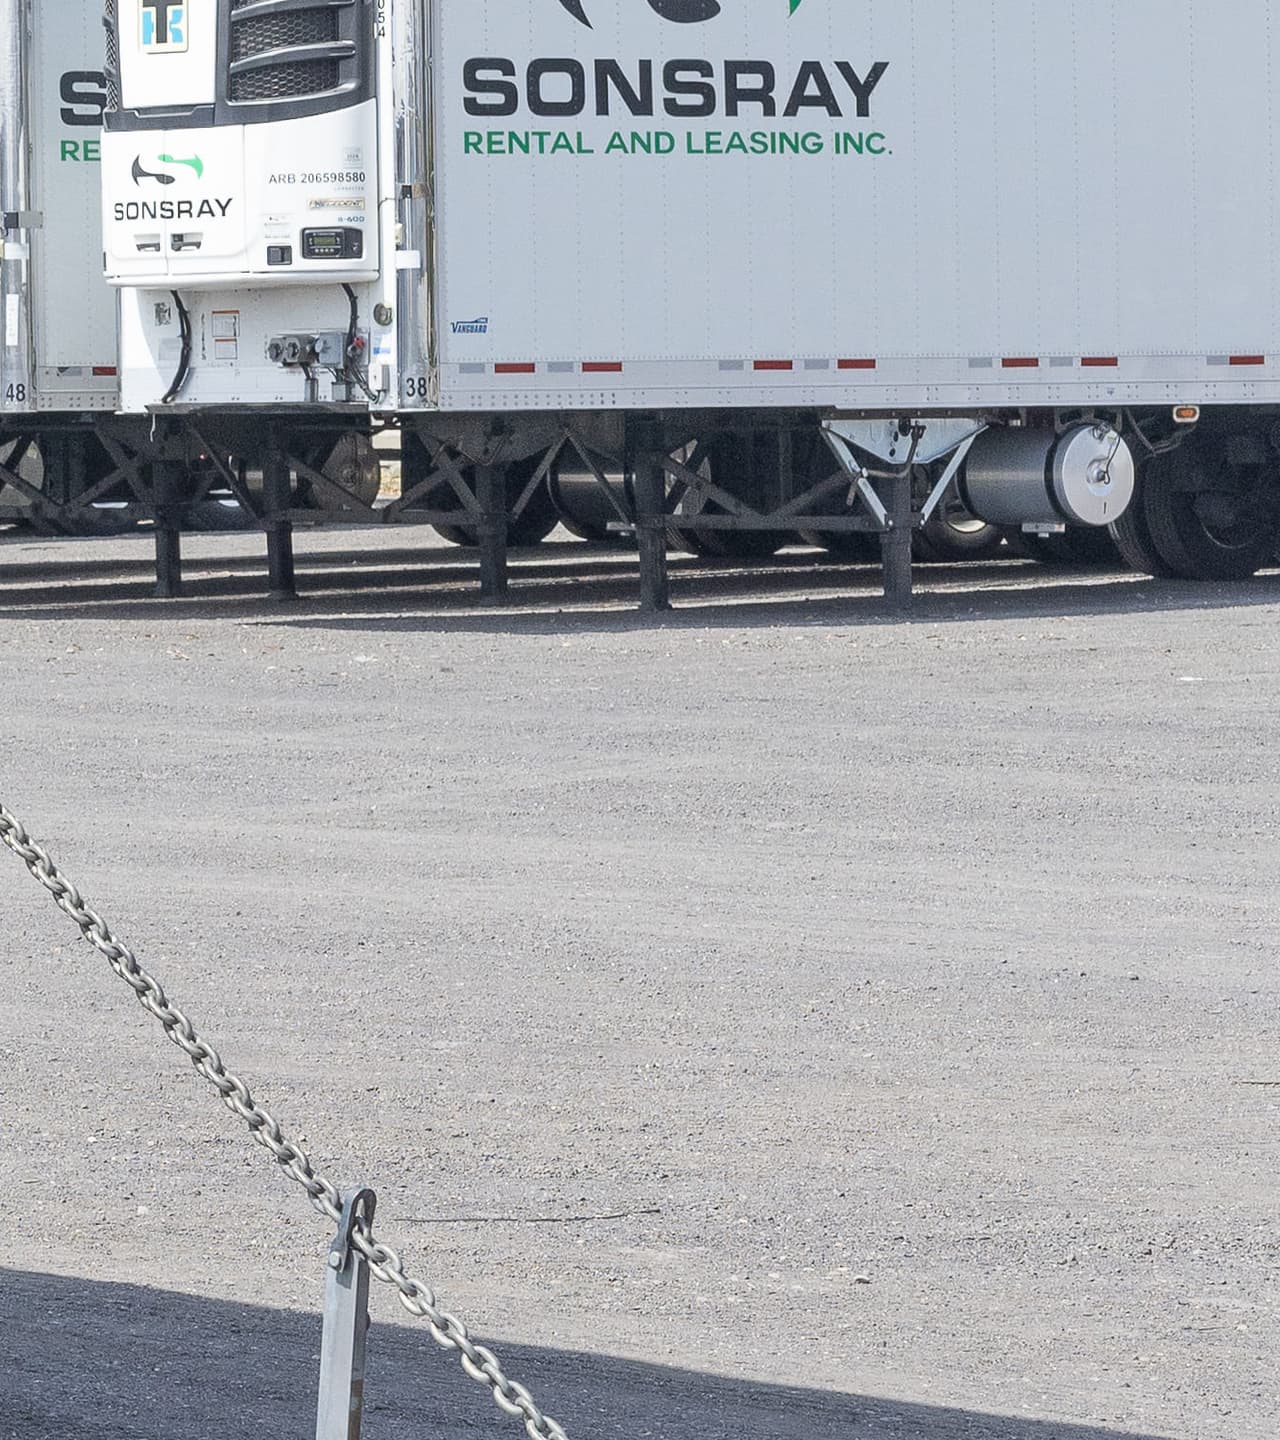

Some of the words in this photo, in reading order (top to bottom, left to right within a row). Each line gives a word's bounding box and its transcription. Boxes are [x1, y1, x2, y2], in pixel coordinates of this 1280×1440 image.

[462, 57, 890, 118] SONSRAY
[463, 130, 594, 155] RENTAL
[604, 130, 676, 155] AND
[686, 130, 824, 155] LEASING
[834, 130, 894, 156] INC.
[269, 172, 296, 184] ARB
[114, 197, 233, 221] SONSRAY
[451, 321, 488, 334] VANGUARD
[6, 383, 26, 402] 48
